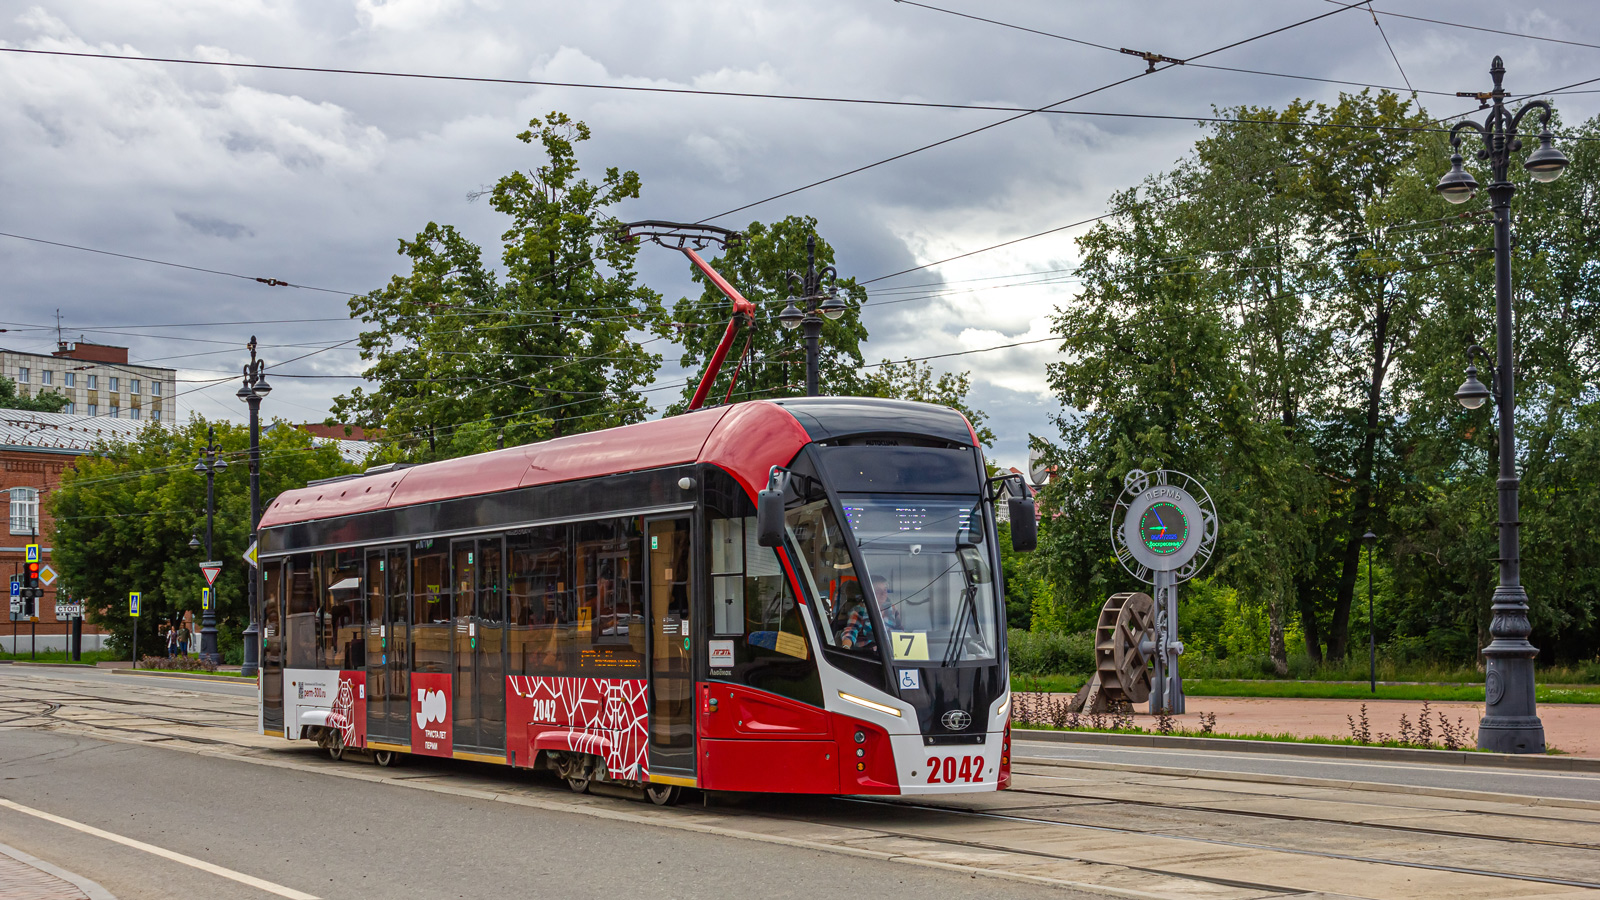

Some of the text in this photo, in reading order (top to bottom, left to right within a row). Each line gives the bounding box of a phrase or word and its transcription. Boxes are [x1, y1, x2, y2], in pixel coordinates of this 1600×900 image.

[1145, 488, 1181, 500] ПЕРМЬ
[580, 608, 588, 628] 7
[900, 635, 915, 657] 7
[416, 688, 447, 730] 300
[533, 699, 556, 722] 2042
[425, 730, 447, 739] ТРИСТА ЛЕТ
[425, 741, 438, 750] ПЕРМИ
[927, 755, 985, 784] 2042
